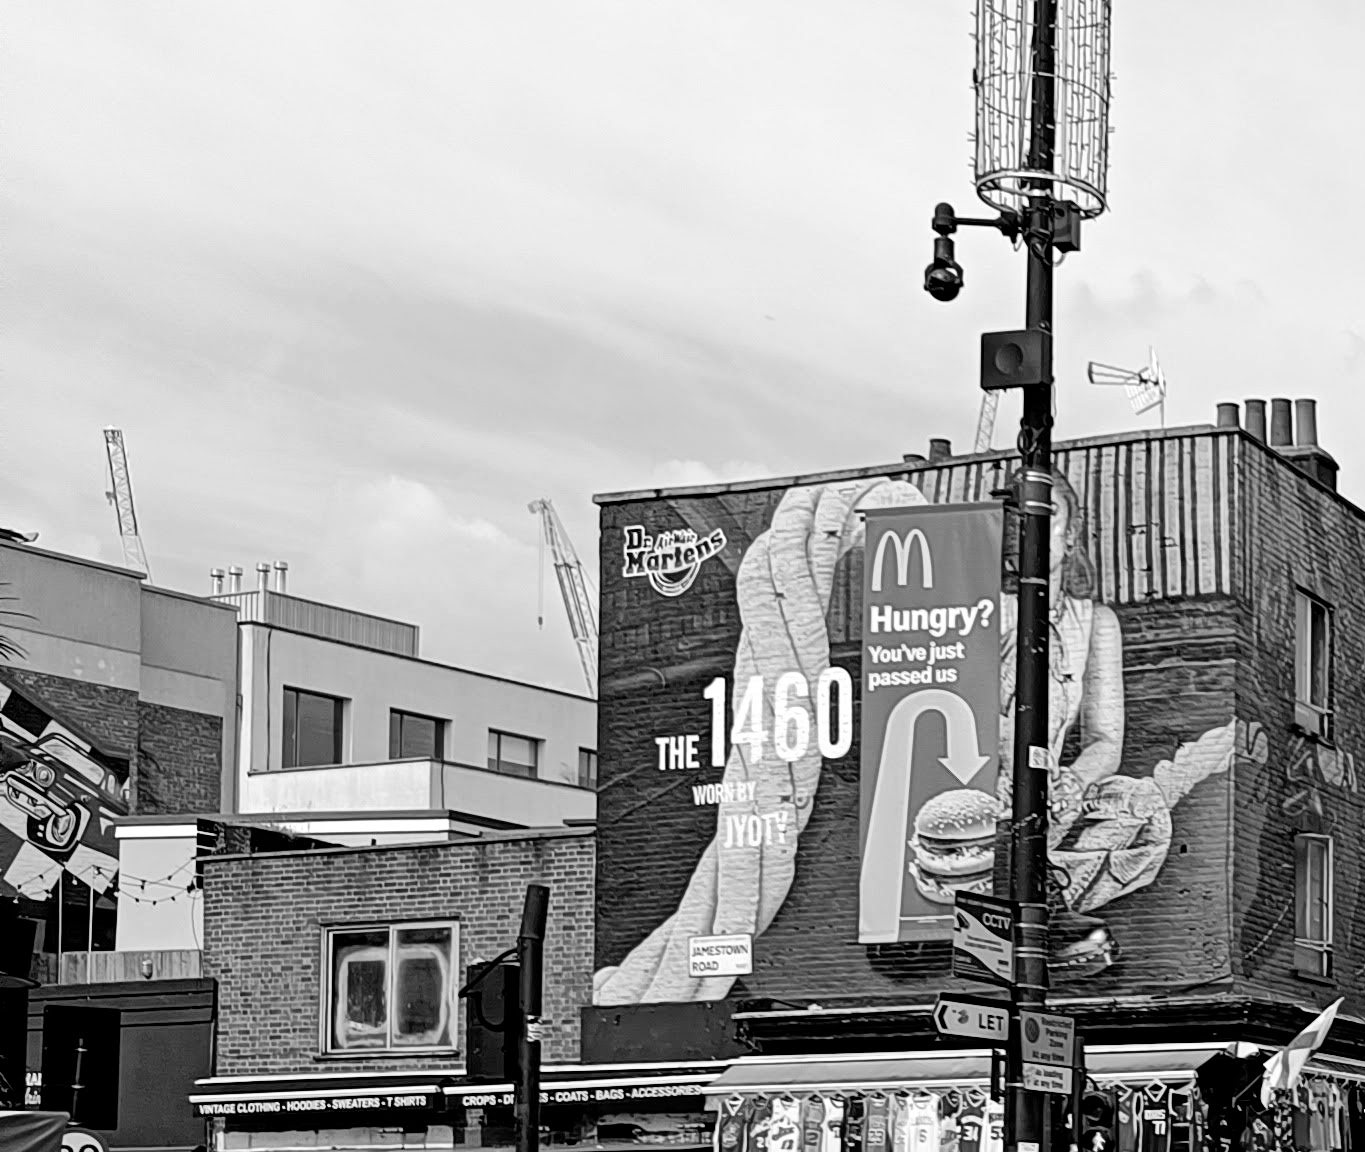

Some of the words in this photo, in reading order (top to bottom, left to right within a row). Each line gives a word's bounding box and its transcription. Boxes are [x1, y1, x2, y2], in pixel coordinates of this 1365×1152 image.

[623, 529, 727, 577] Martens
[870, 599, 994, 638] Hungry?
[868, 643, 927, 664] You've
[927, 641, 966, 665] just
[868, 666, 933, 692] passed
[935, 668, 958, 683] us
[703, 666, 852, 767] 1460
[655, 735, 700, 770] THE
[692, 783, 732, 806] WORN
[739, 781, 757, 803] BY
[982, 913, 1011, 930] CCTV
[691, 944, 749, 958] JAMESTOWN
[692, 960, 720, 972] ROAD
[199, 1103, 236, 1115] VINTAGE
[237, 1102, 281, 1114] CLOTHING
[286, 1100, 327, 1112] HOODIES
[331, 1097, 380, 1110] SWEATERS
[387, 1097, 394, 1107] T
[394, 1095, 427, 1107] SHIRTS
[463, 1095, 497, 1107] CROPS
[555, 1090, 589, 1103] COATS
[595, 1089, 625, 1101] BAGS
[631, 1085, 702, 1099] ACCESSORIES
